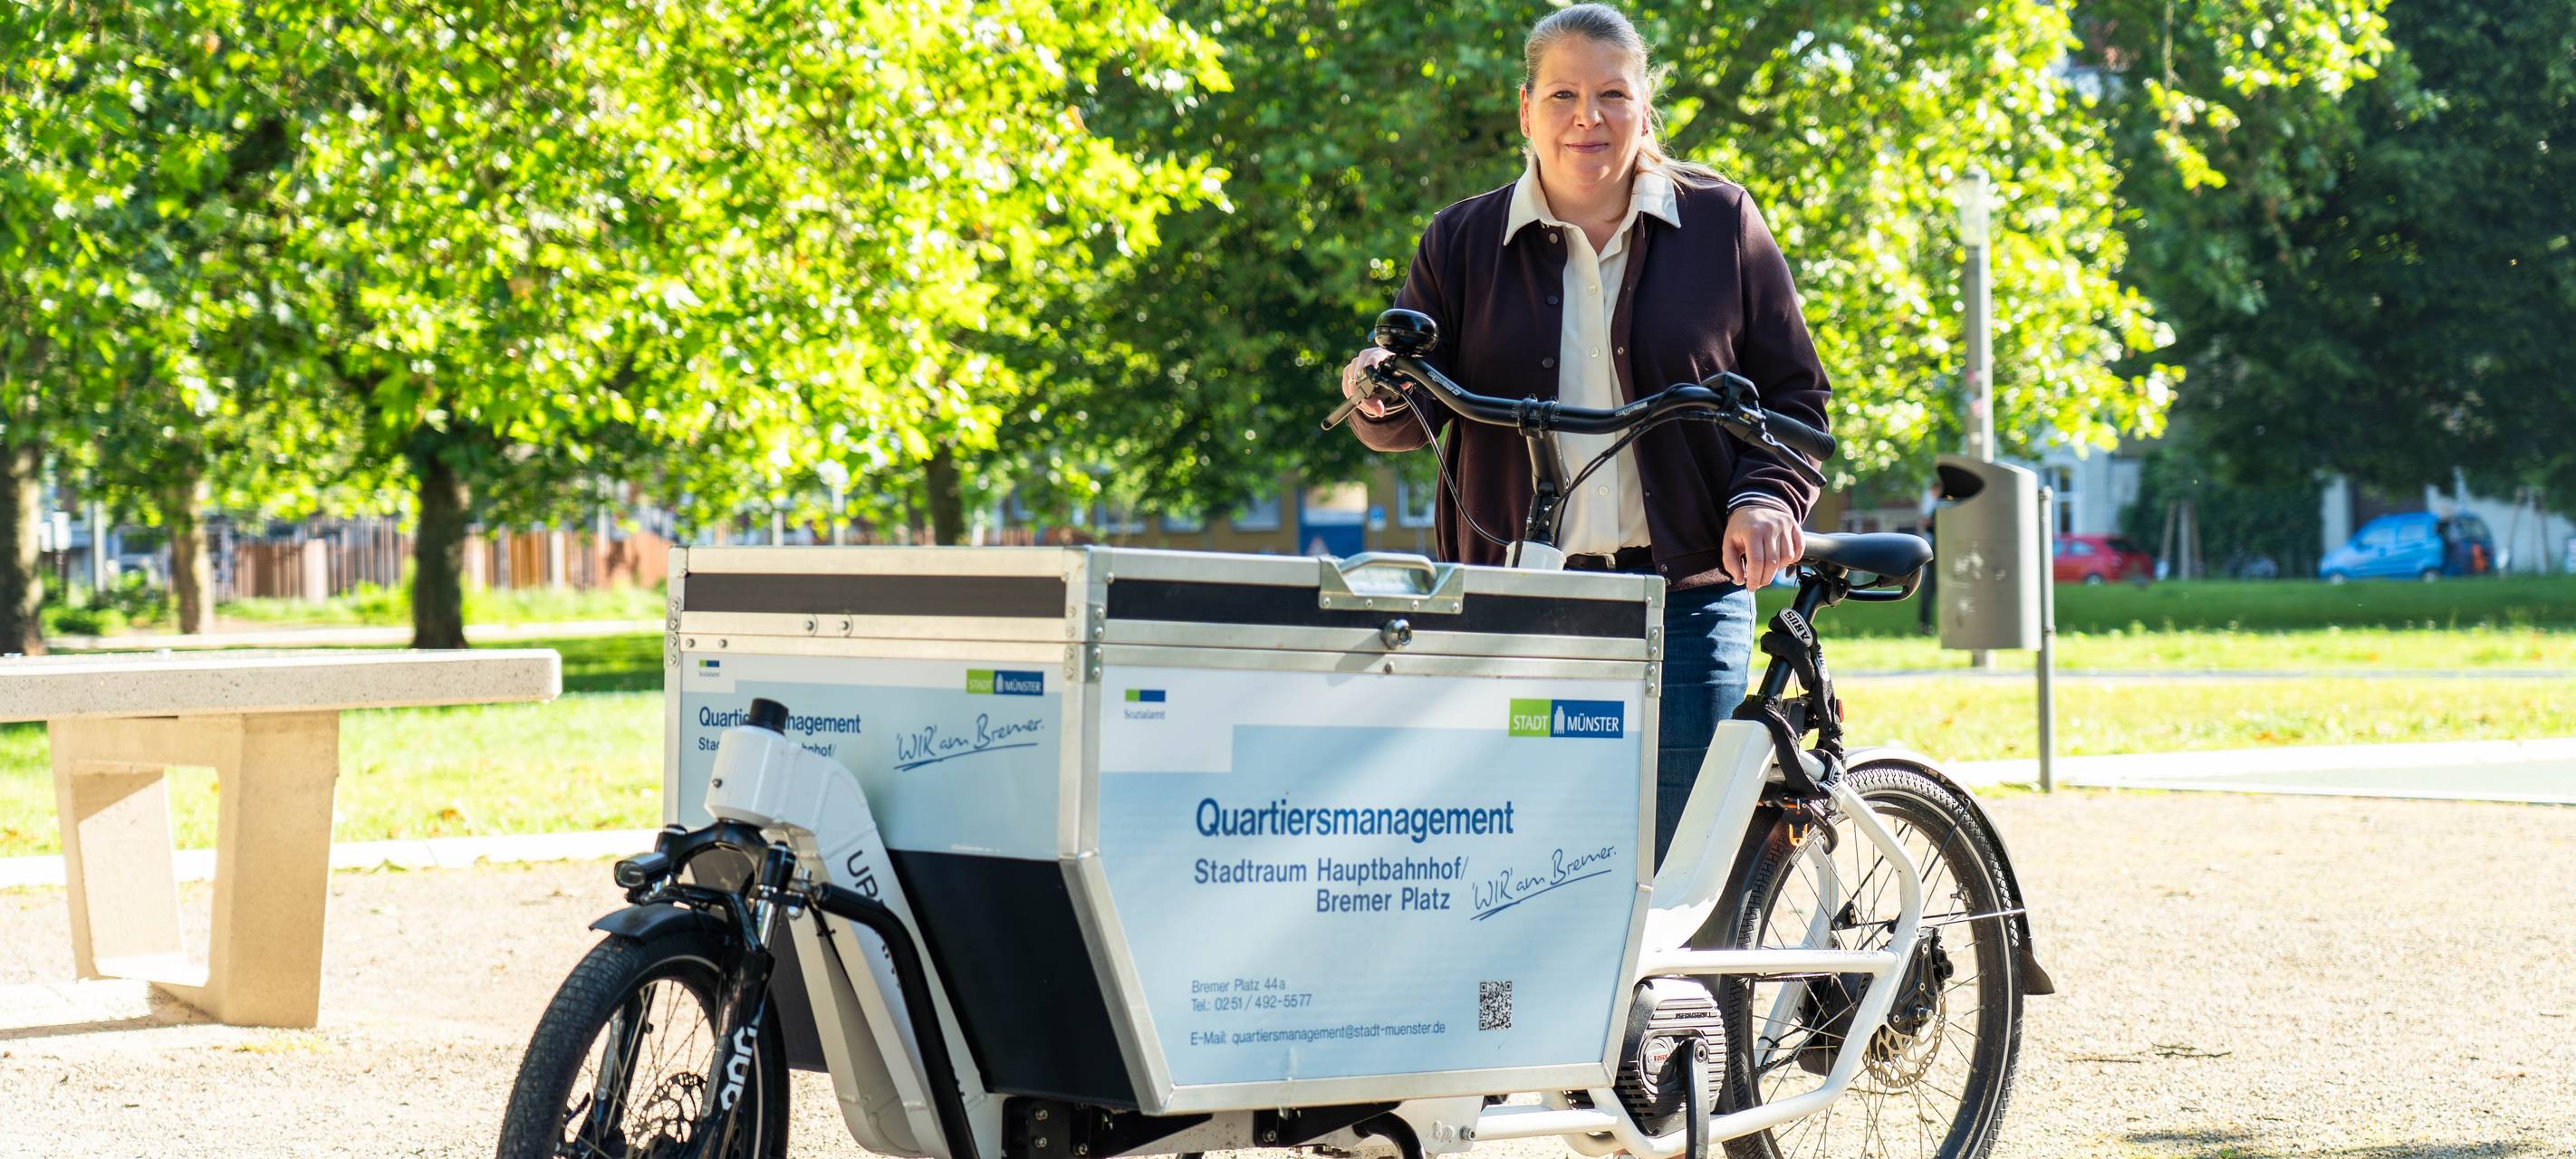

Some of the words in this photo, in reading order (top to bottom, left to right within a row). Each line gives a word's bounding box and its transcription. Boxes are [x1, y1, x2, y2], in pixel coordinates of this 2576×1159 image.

[1784, 610, 1811, 641] ABUS
[969, 679, 993, 691] STADT
[1514, 714, 1548, 731] STADT
[1567, 713, 1620, 733] MÜNSTER
[1196, 797, 1514, 844] Quartiersmanagement
[1194, 857, 1308, 884] Stadtraum
[1317, 855, 1469, 886] Hauptbahnhof/
[1516, 876, 1545, 892] am
[1317, 888, 1392, 913] Bremer
[1401, 886, 1450, 911] Platz
[1192, 980, 1230, 994] Bremer
[1235, 978, 1260, 991] Platz
[1191, 998, 1211, 1012] Tel.:
[1190, 1030, 1227, 1046] E-Mail:
[1232, 1020, 1446, 1047] quartiersmanagement@stadt-muenster.de
